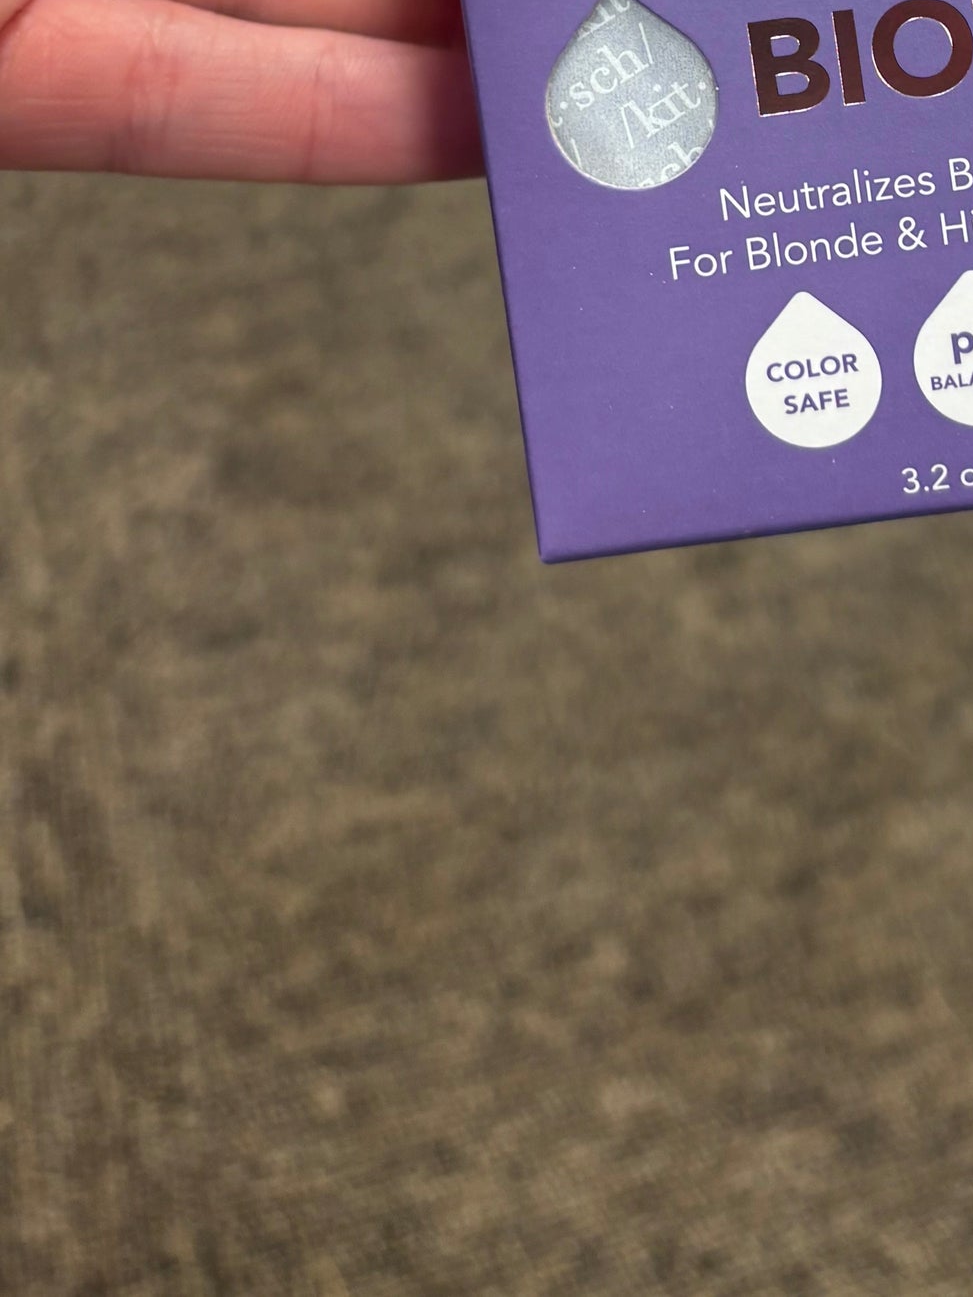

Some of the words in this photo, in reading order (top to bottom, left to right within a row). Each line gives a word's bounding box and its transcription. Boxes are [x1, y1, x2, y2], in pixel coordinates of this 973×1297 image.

[720, 159, 938, 222] Neutralizes
[670, 244, 733, 281] For
[746, 222, 883, 271] Blonde
[898, 216, 927, 251] &
[766, 353, 859, 383] COLOR
[783, 388, 850, 415] SAFE
[901, 464, 950, 494] 3.2
